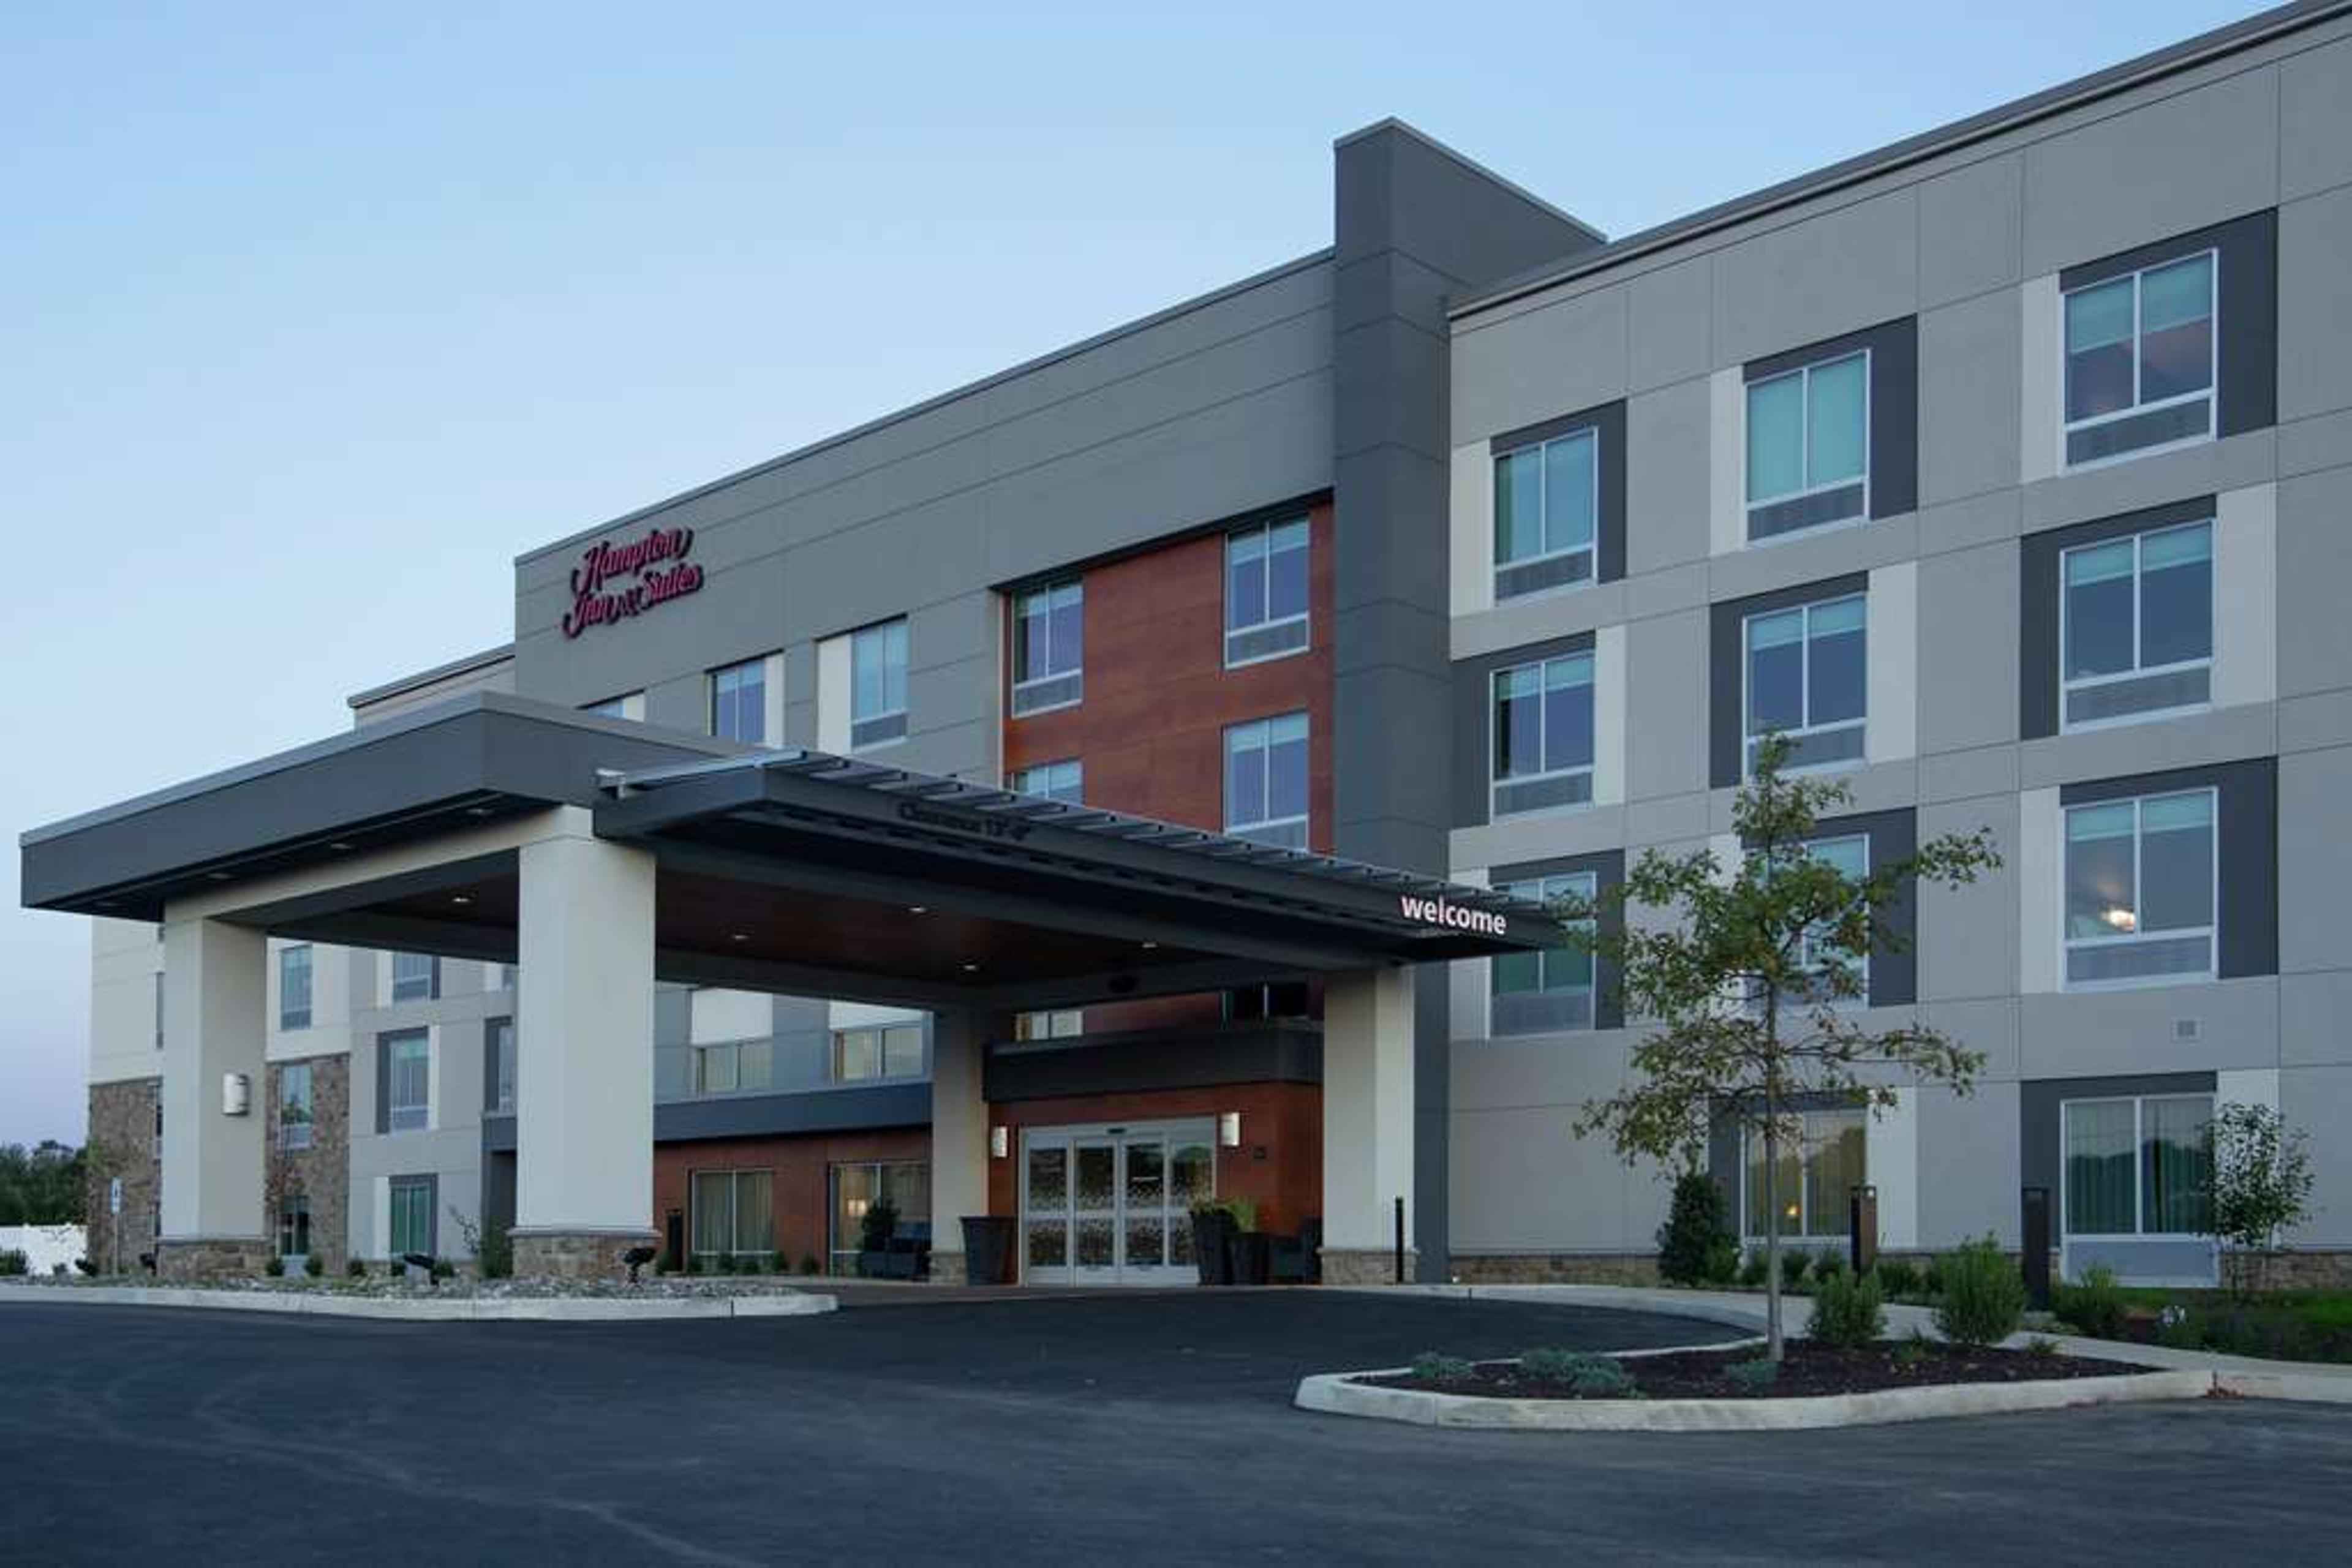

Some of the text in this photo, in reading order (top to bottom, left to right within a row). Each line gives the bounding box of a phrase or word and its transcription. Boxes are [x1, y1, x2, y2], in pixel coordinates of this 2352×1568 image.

[571, 528, 695, 590] Hampton
[563, 593, 621, 638] Inn
[641, 562, 704, 610] Suites
[1400, 895, 1507, 935] welcome
